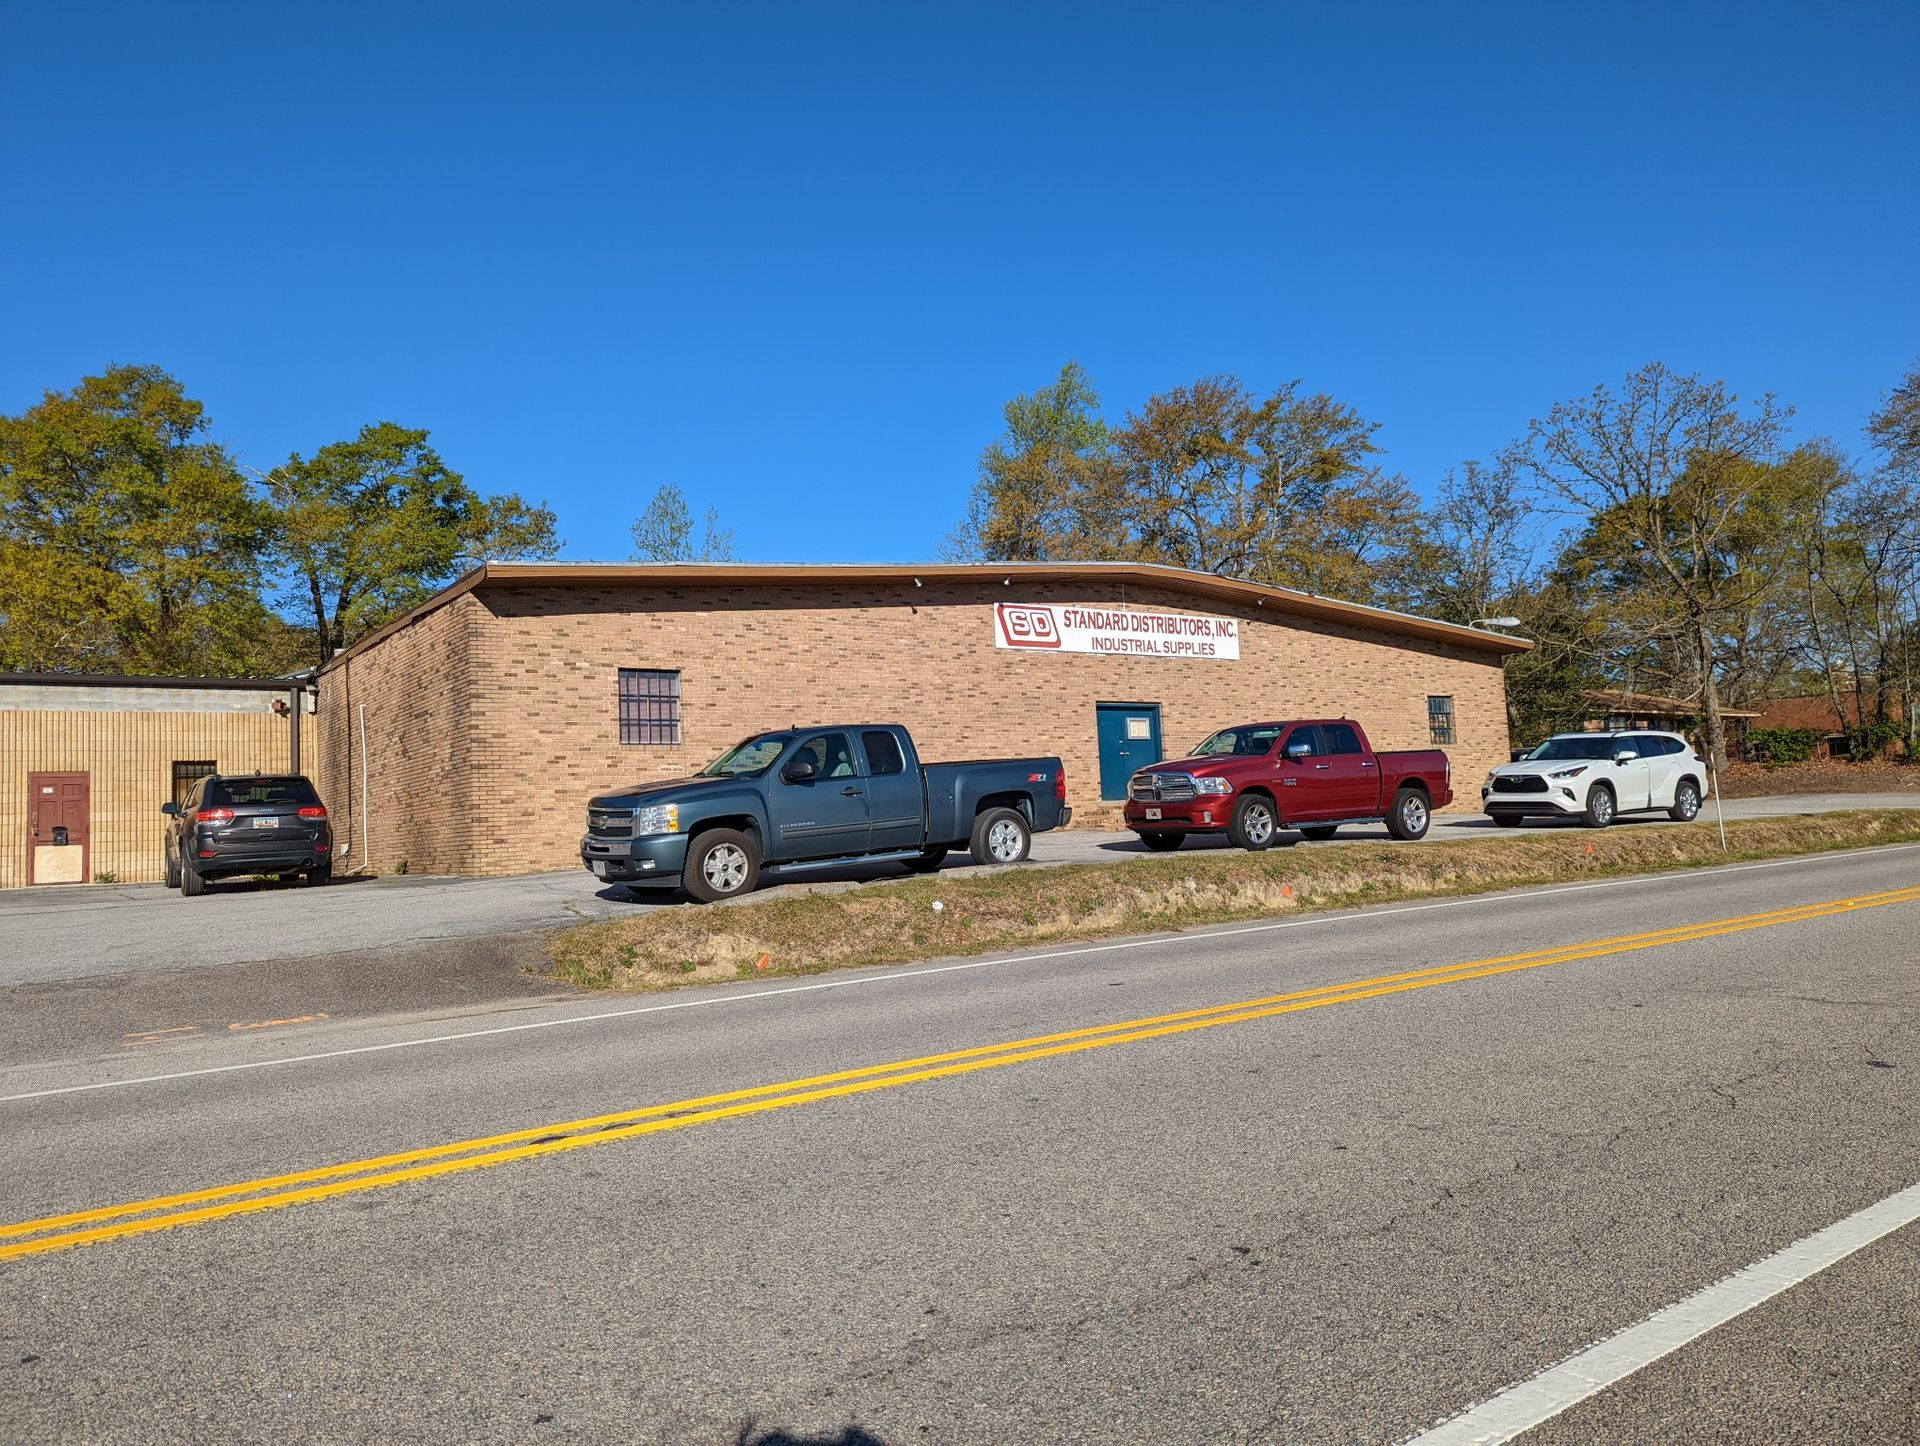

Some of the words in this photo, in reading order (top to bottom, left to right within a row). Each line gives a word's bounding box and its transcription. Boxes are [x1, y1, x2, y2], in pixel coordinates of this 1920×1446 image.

[1009, 611, 1051, 637] SD
[1064, 609, 1129, 631] STANDARD
[1131, 614, 1215, 640] DISTRIBUTORS,
[1215, 620, 1237, 638] INC.
[1092, 637, 1161, 653] INDUSTRIAL
[1163, 641, 1215, 656] SUPPLIES
